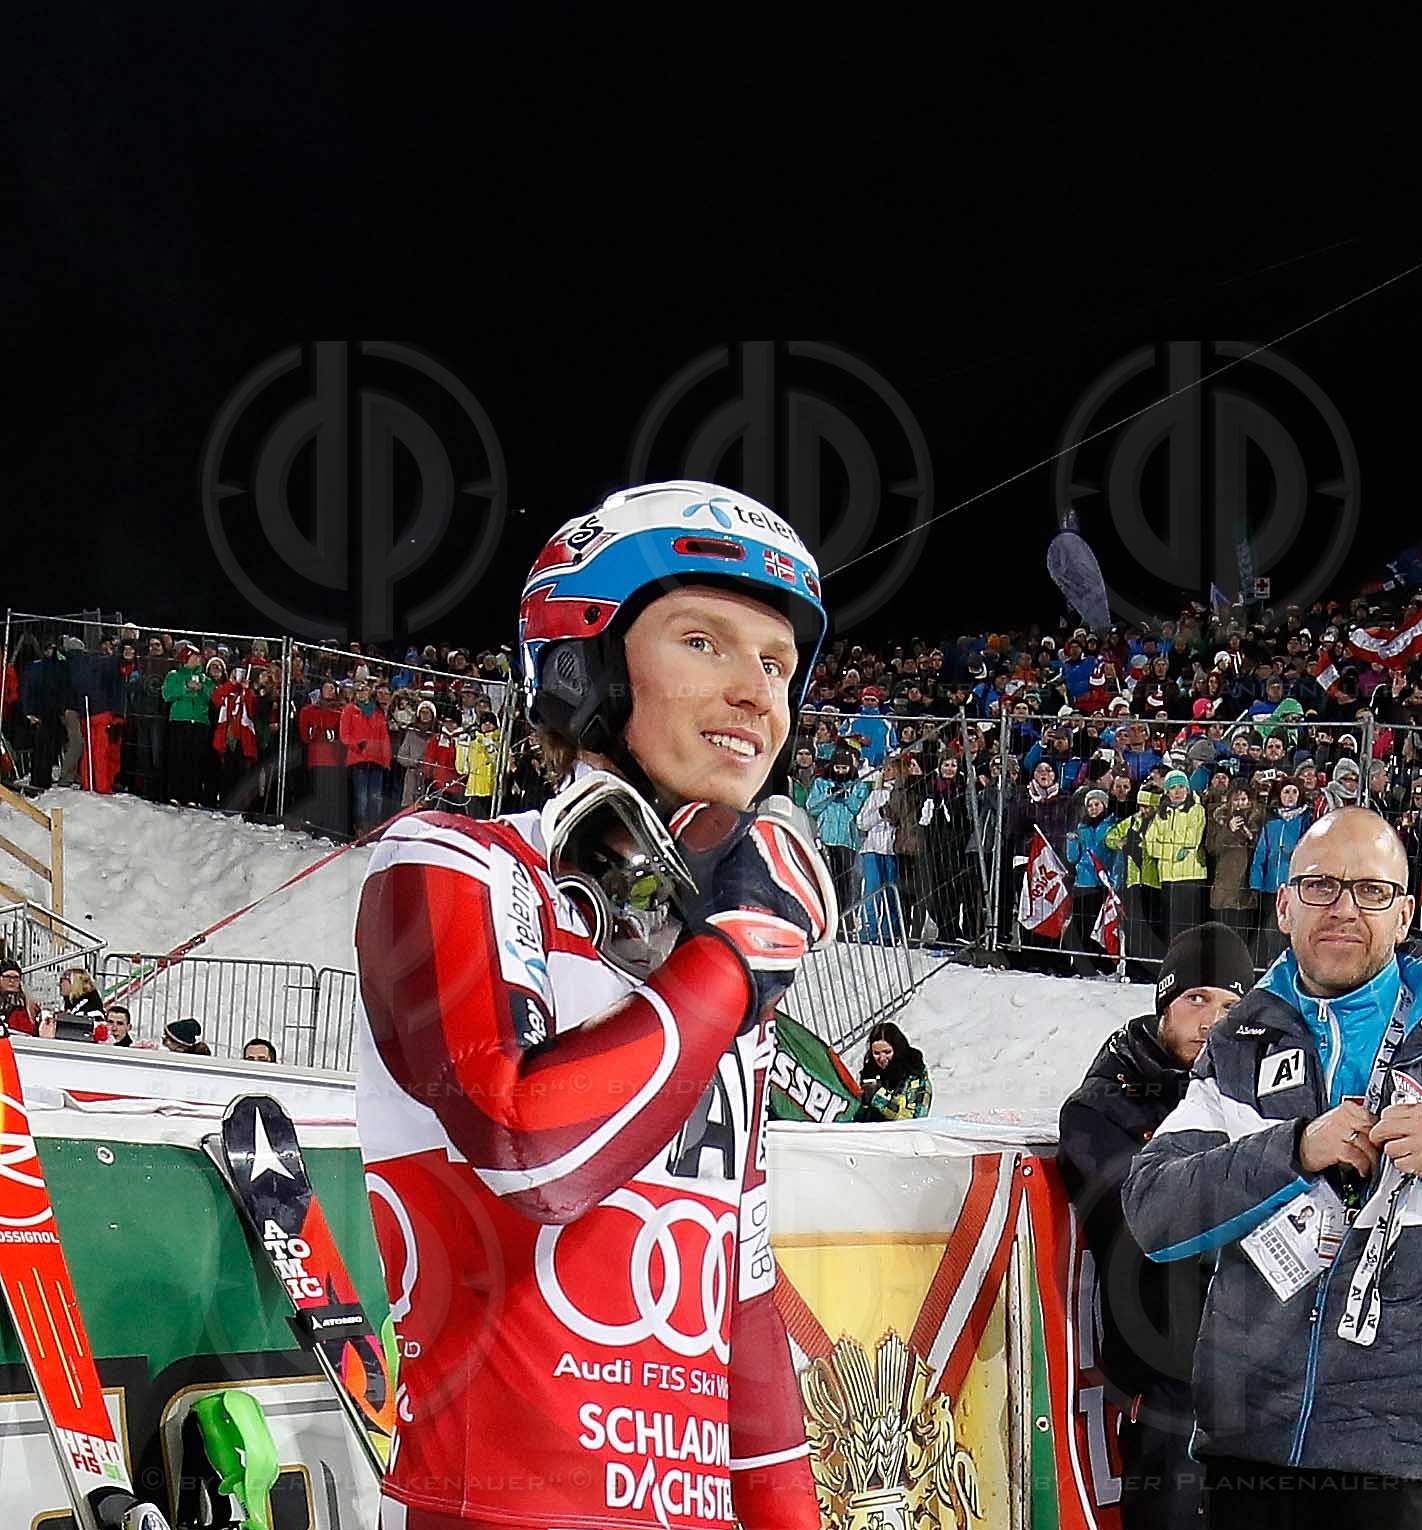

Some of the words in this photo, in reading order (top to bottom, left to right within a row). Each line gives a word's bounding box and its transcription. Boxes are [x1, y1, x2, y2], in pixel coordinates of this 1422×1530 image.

[1272, 1051, 1299, 1088] A1
[553, 1353, 632, 1385] Audi
[643, 1363, 686, 1392] FIS
[689, 1369, 716, 1398] Ski
